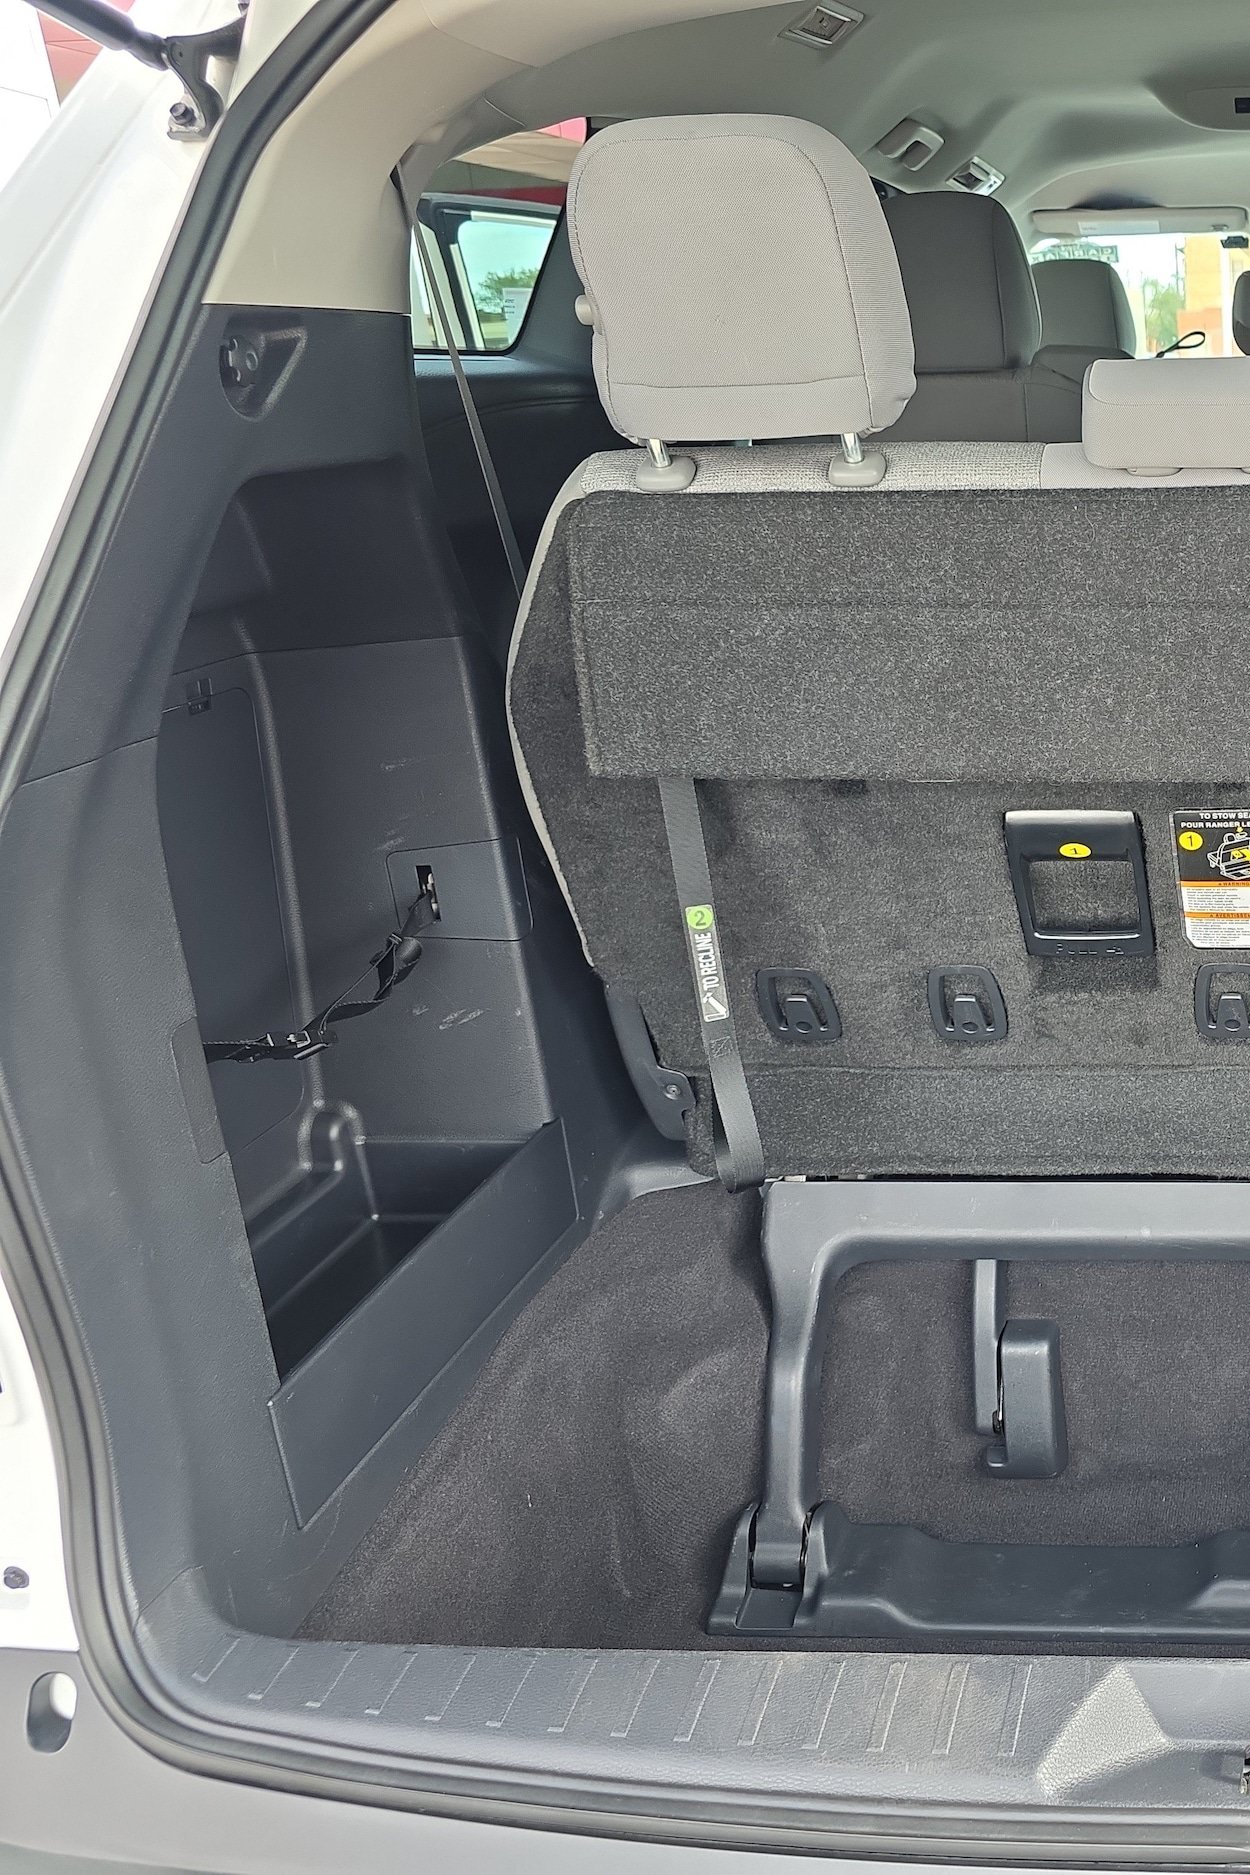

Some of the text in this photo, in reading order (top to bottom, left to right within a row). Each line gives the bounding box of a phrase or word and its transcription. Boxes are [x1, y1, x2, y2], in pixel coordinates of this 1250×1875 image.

[1199, 812, 1212, 820] TO
[1212, 812, 1236, 820] STOW
[694, 911, 707, 926] 2
[694, 932, 719, 990] TO RECLINE
